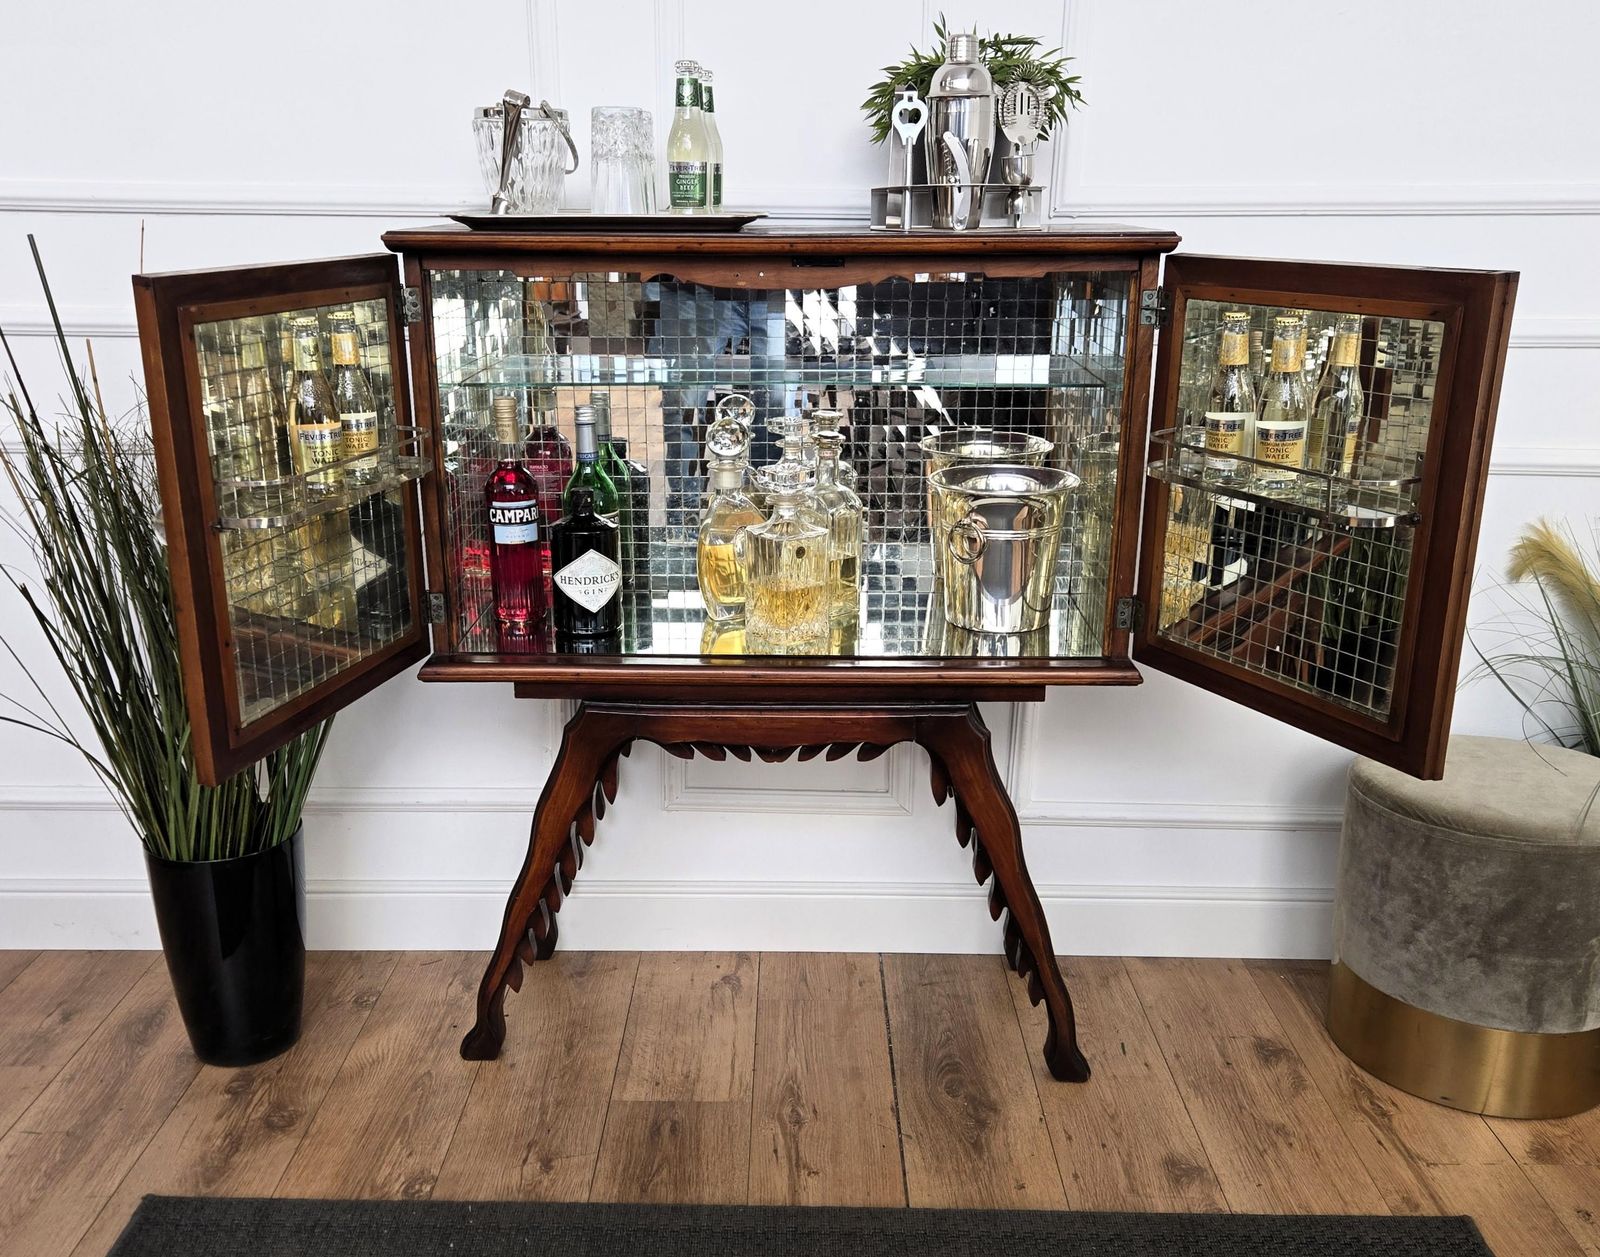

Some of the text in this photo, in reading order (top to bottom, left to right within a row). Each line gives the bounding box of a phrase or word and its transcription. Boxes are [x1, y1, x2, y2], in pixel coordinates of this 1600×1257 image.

[1258, 431, 1303, 439] FEVER-TREE
[312, 449, 338, 458] TONIC
[1265, 446, 1290, 454] TONIC
[583, 587, 604, 596] GIN
